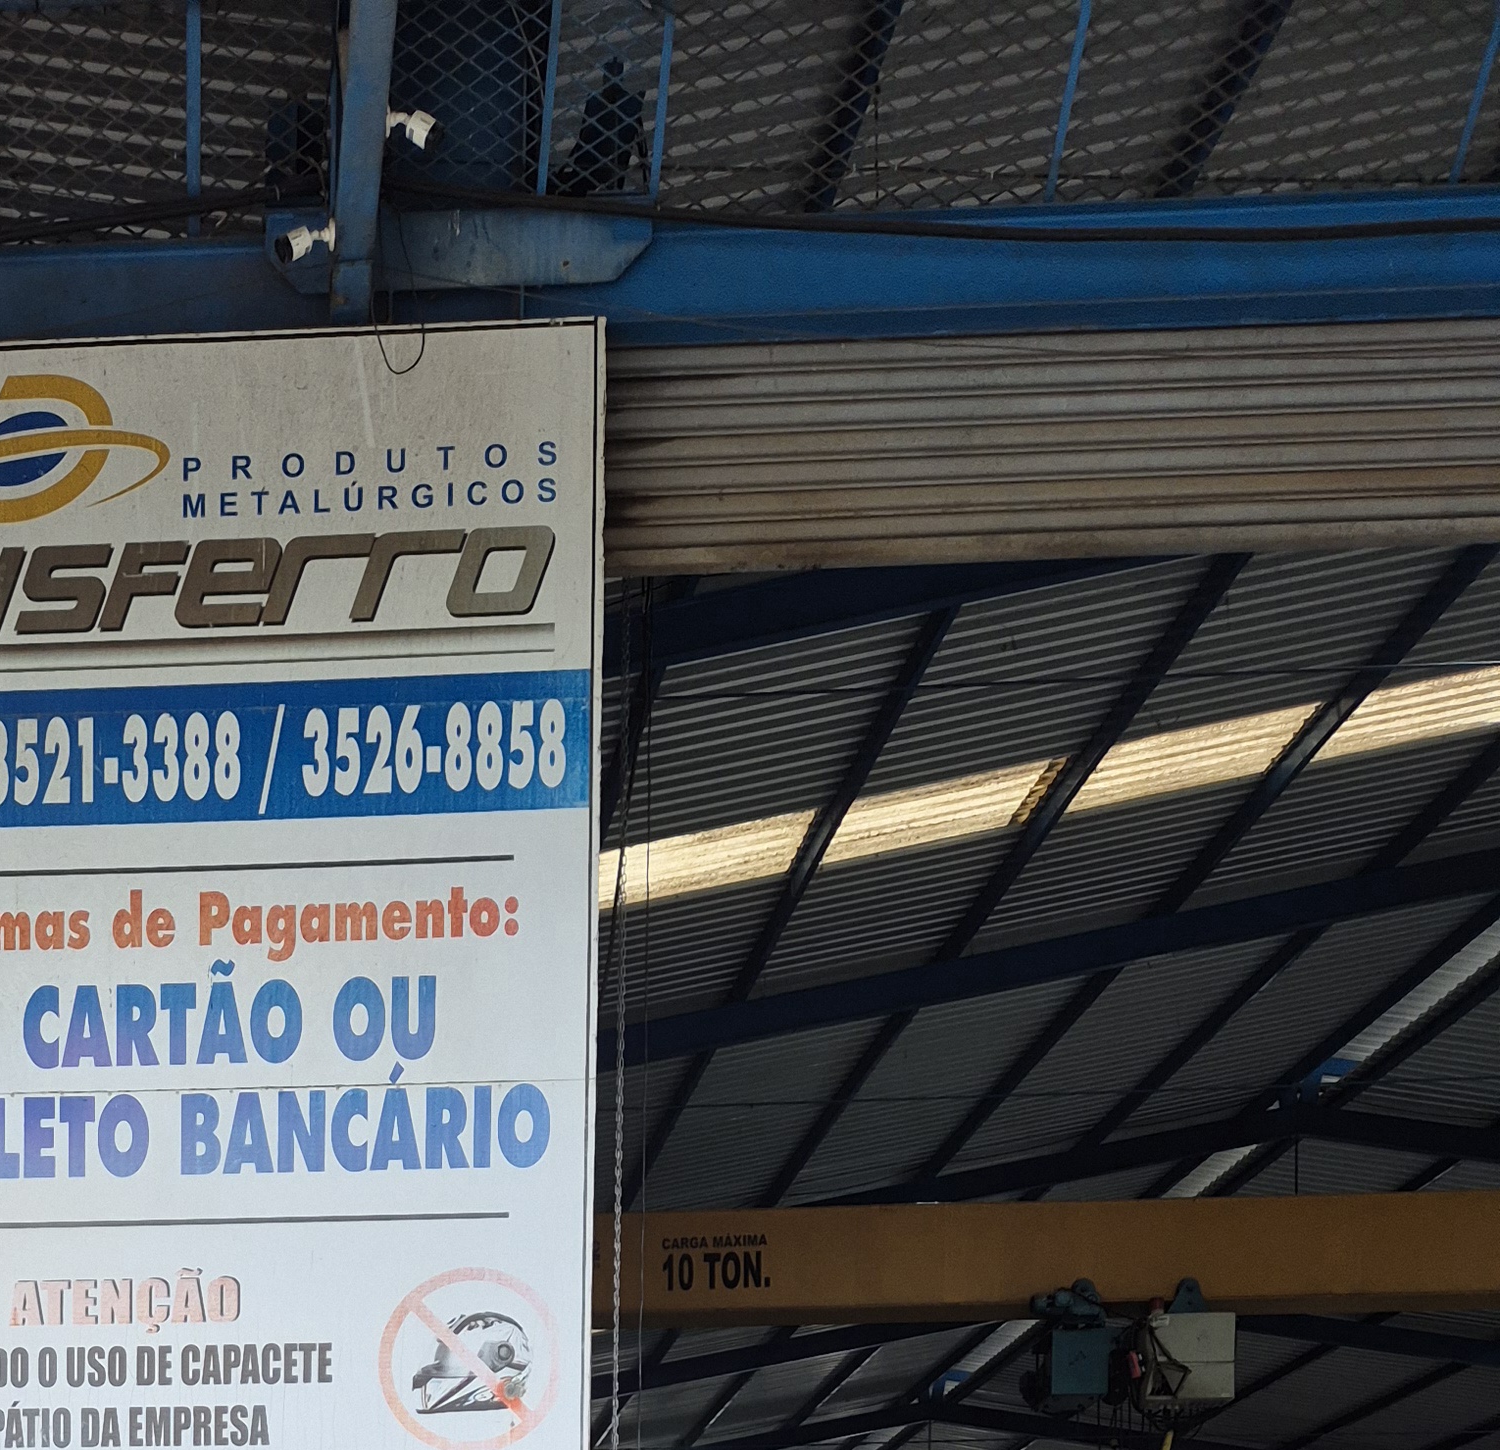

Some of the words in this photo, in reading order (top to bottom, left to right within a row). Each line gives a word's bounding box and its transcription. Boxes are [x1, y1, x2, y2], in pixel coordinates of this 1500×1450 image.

[182, 440, 558, 482] PRODUTOS
[181, 477, 558, 519] METALÚRGICOS
[258, 704, 286, 814] /
[302, 698, 566, 798] 3526-8858
[112, 889, 175, 949] de
[199, 886, 519, 961] Pagamento:
[23, 959, 302, 1069] CARTÃO
[334, 975, 437, 1062] OU
[180, 1061, 551, 1176] BANCÁRIO
[661, 1237, 708, 1250] CARGA
[712, 1233, 768, 1248] MÁXIMA
[662, 1253, 694, 1291] 10
[703, 1251, 771, 1290] TON.
[10, 1267, 241, 1334] ATENÇÃO
[37, 1346, 57, 1388] O
[66, 1345, 127, 1387] USO
[136, 1345, 173, 1386] DE
[180, 1342, 333, 1385] CAPACETE
[80, 1406, 122, 1448] DA
[129, 1405, 270, 1447] EMPRESA
